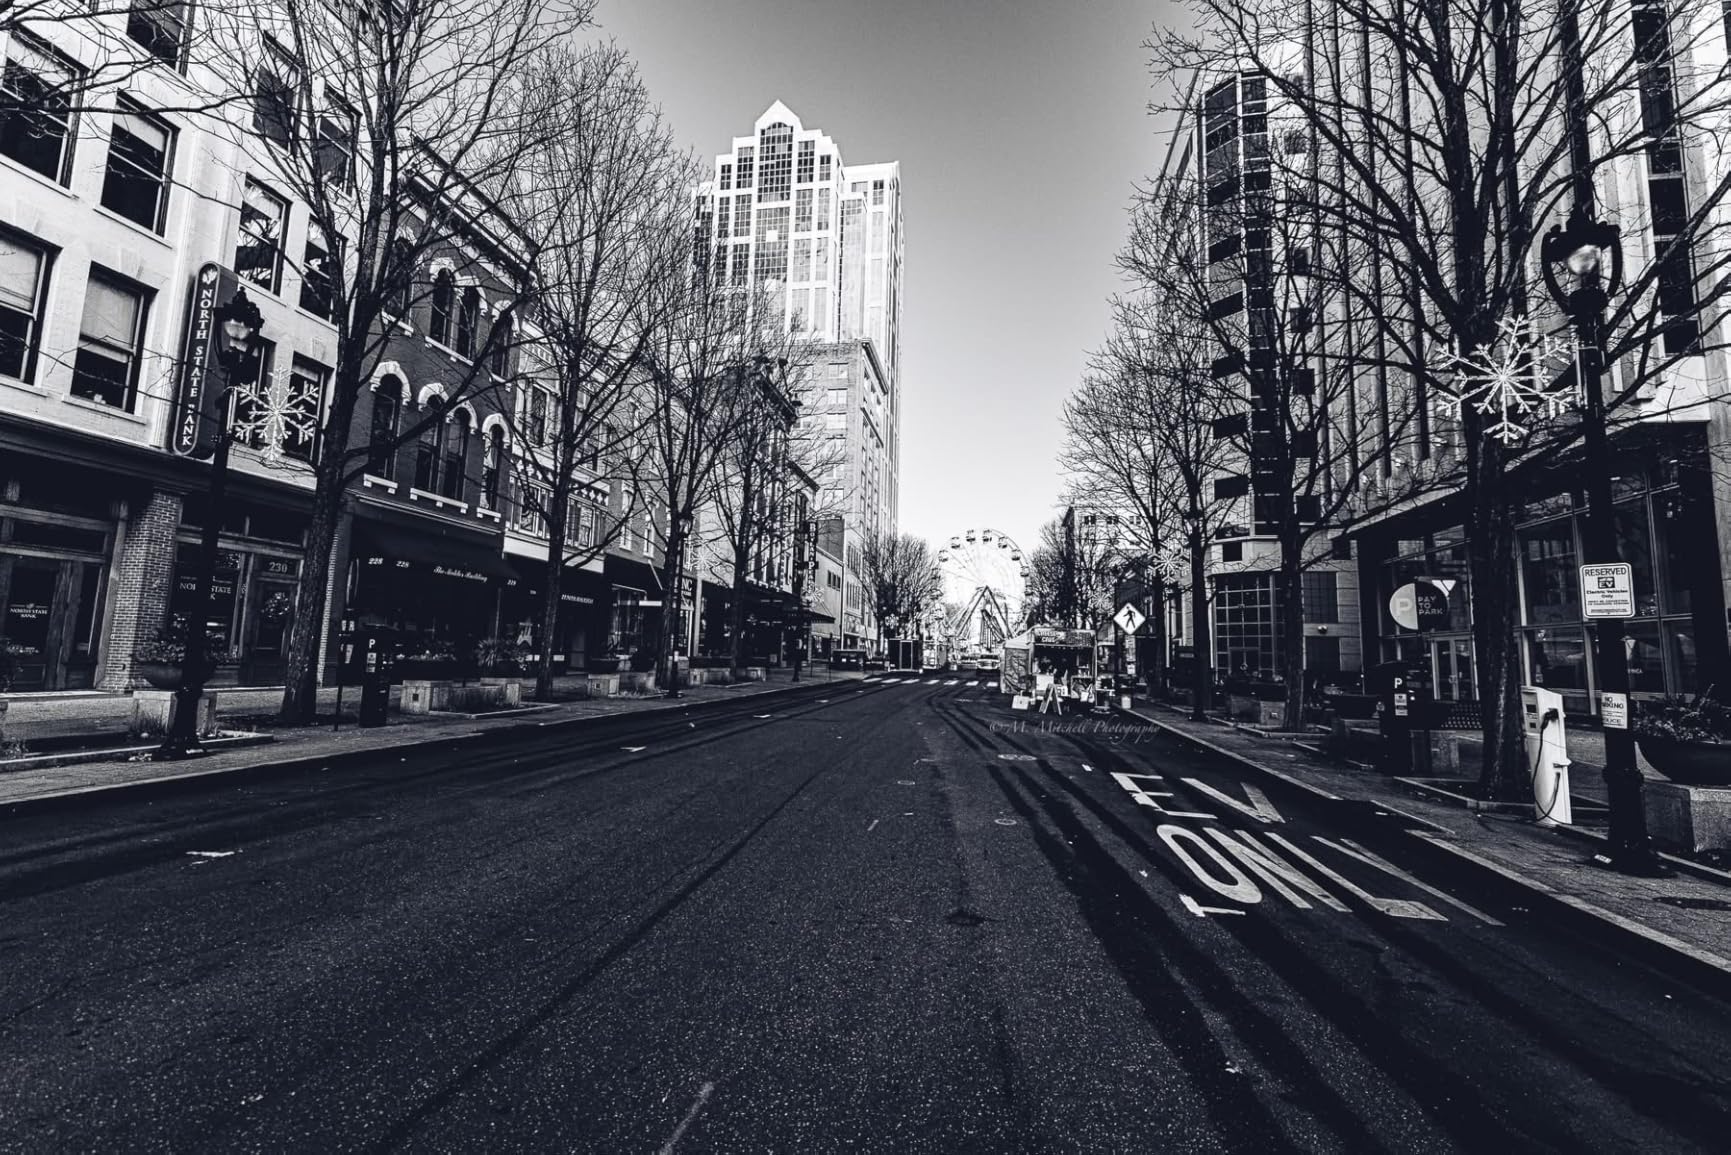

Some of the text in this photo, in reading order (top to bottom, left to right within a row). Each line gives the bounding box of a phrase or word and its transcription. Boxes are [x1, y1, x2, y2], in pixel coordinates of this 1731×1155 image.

[182, 288, 213, 446] NORTH STATE BANK
[268, 561, 289, 574] 230
[1584, 567, 1627, 577] RESERVED
[1598, 580, 1614, 588] EV
[1418, 608, 1443, 616] PARK
[368, 638, 376, 649] P
[1394, 677, 1403, 689] P
[1111, 771, 1286, 824] EV
[1156, 823, 1507, 927] ONLY
